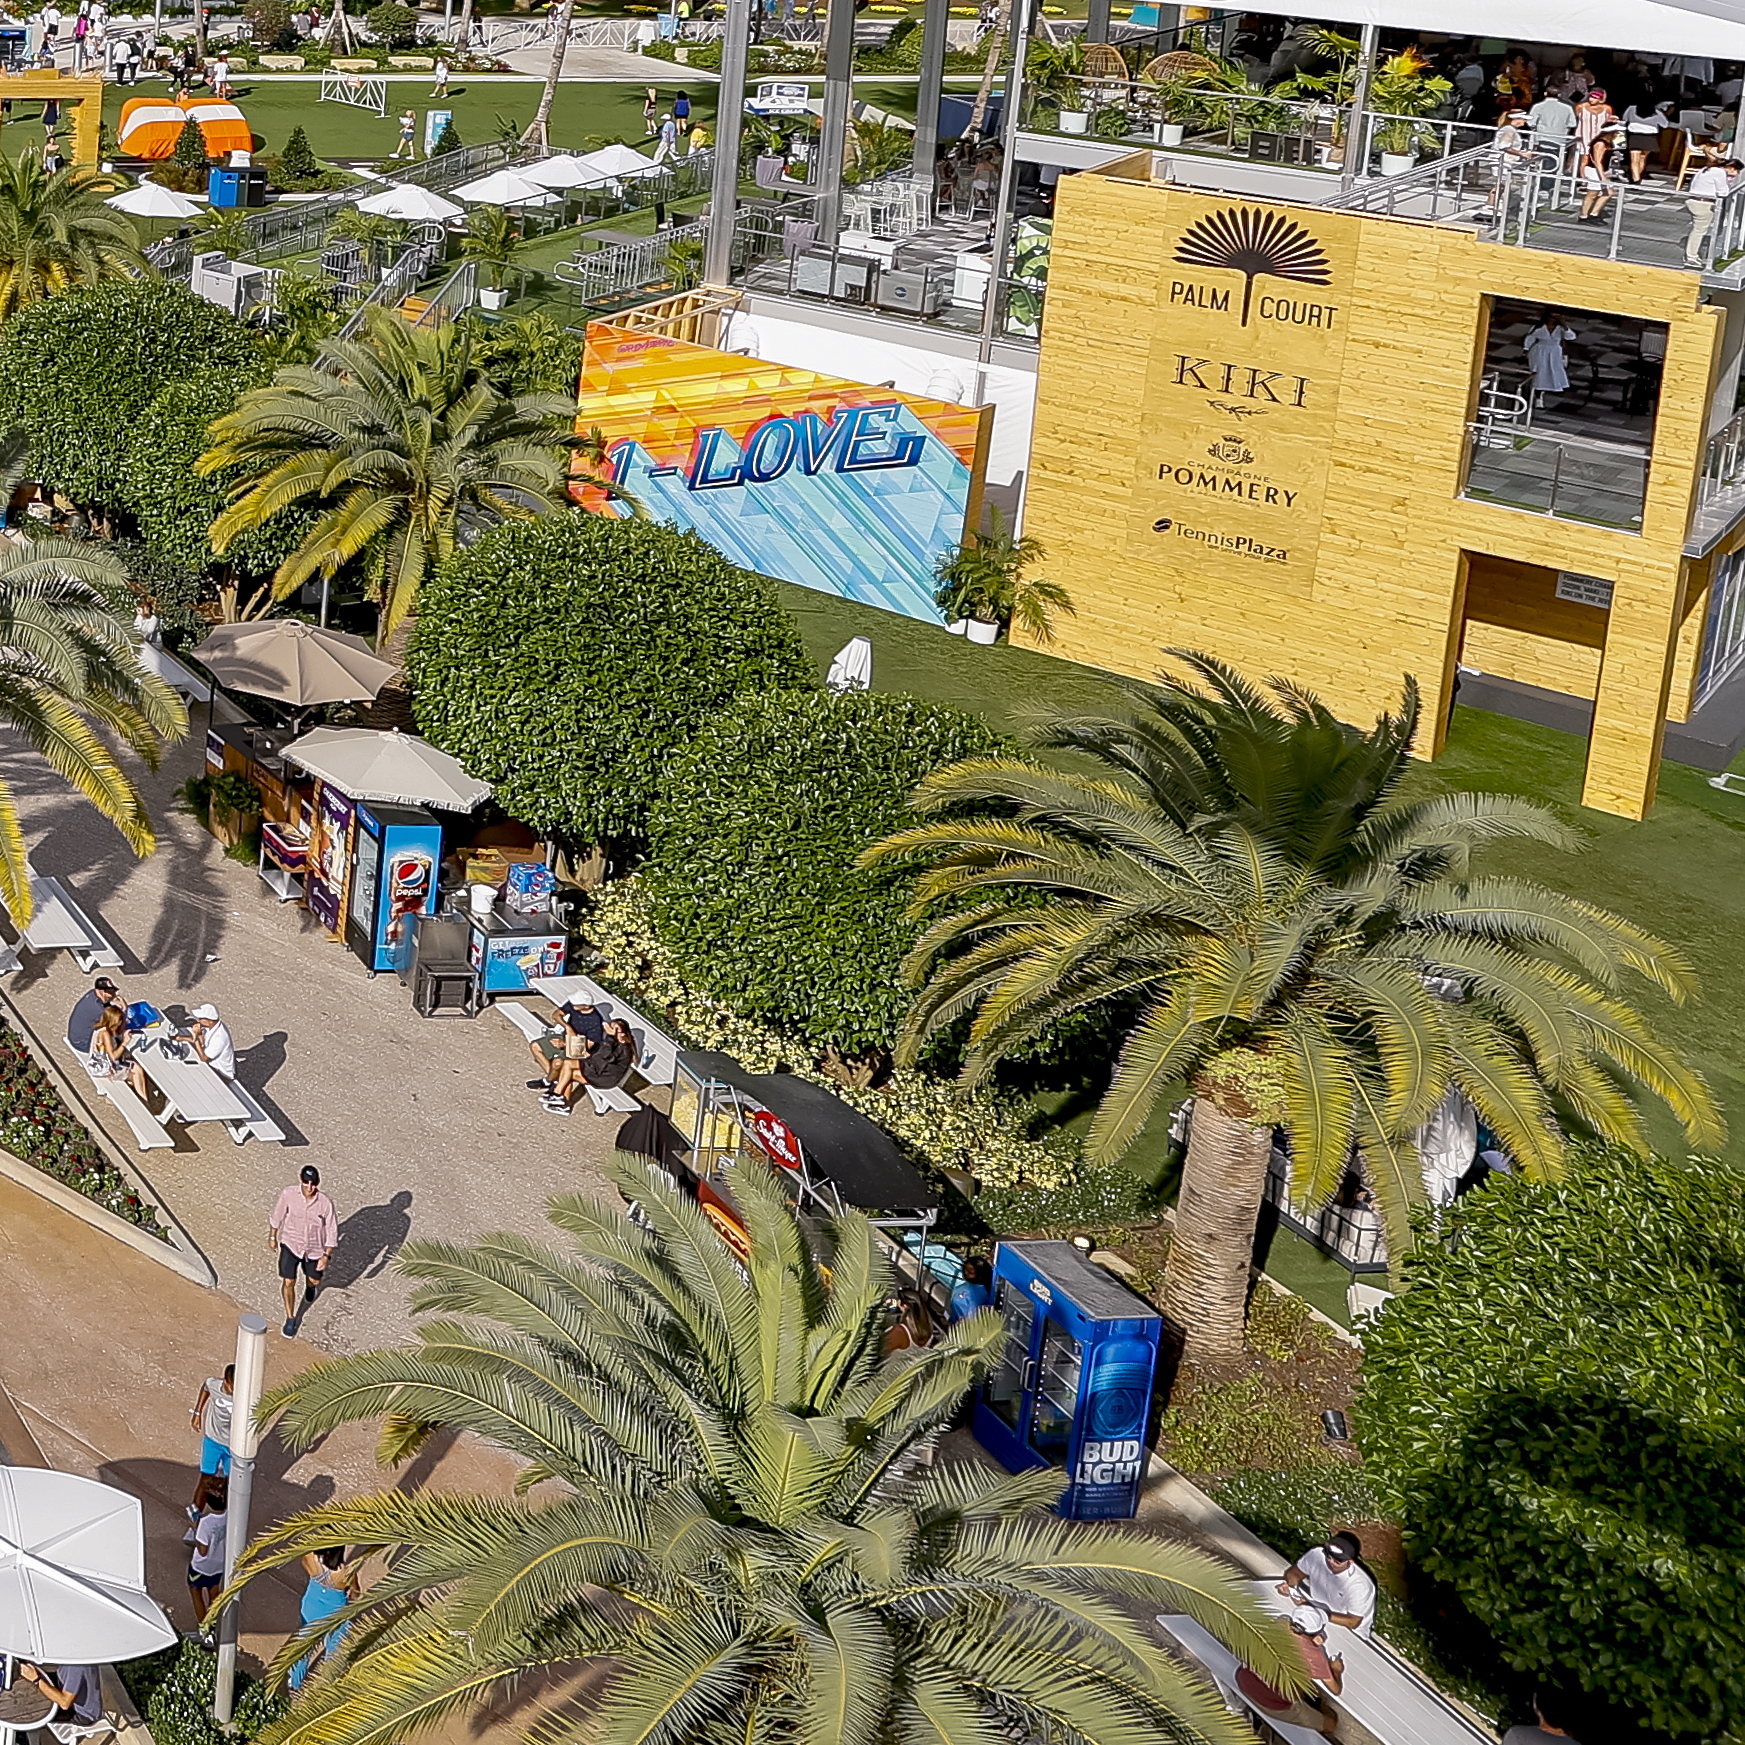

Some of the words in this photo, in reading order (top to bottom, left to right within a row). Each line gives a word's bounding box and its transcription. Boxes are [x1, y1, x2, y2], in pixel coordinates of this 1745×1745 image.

[1169, 281, 1230, 312] PALM
[1259, 296, 1339, 329] COURT
[1170, 353, 1314, 409] KIKI
[1187, 460, 1271, 483] CHAMPAGNE
[1158, 463, 1299, 508] POMMERY
[1174, 521, 1288, 560] TennisPlaza
[395, 887, 423, 897] pepsi
[491, 941, 510, 950] GET
[491, 945, 530, 960] FREEZE
[1082, 1440, 1140, 1463] BUD
